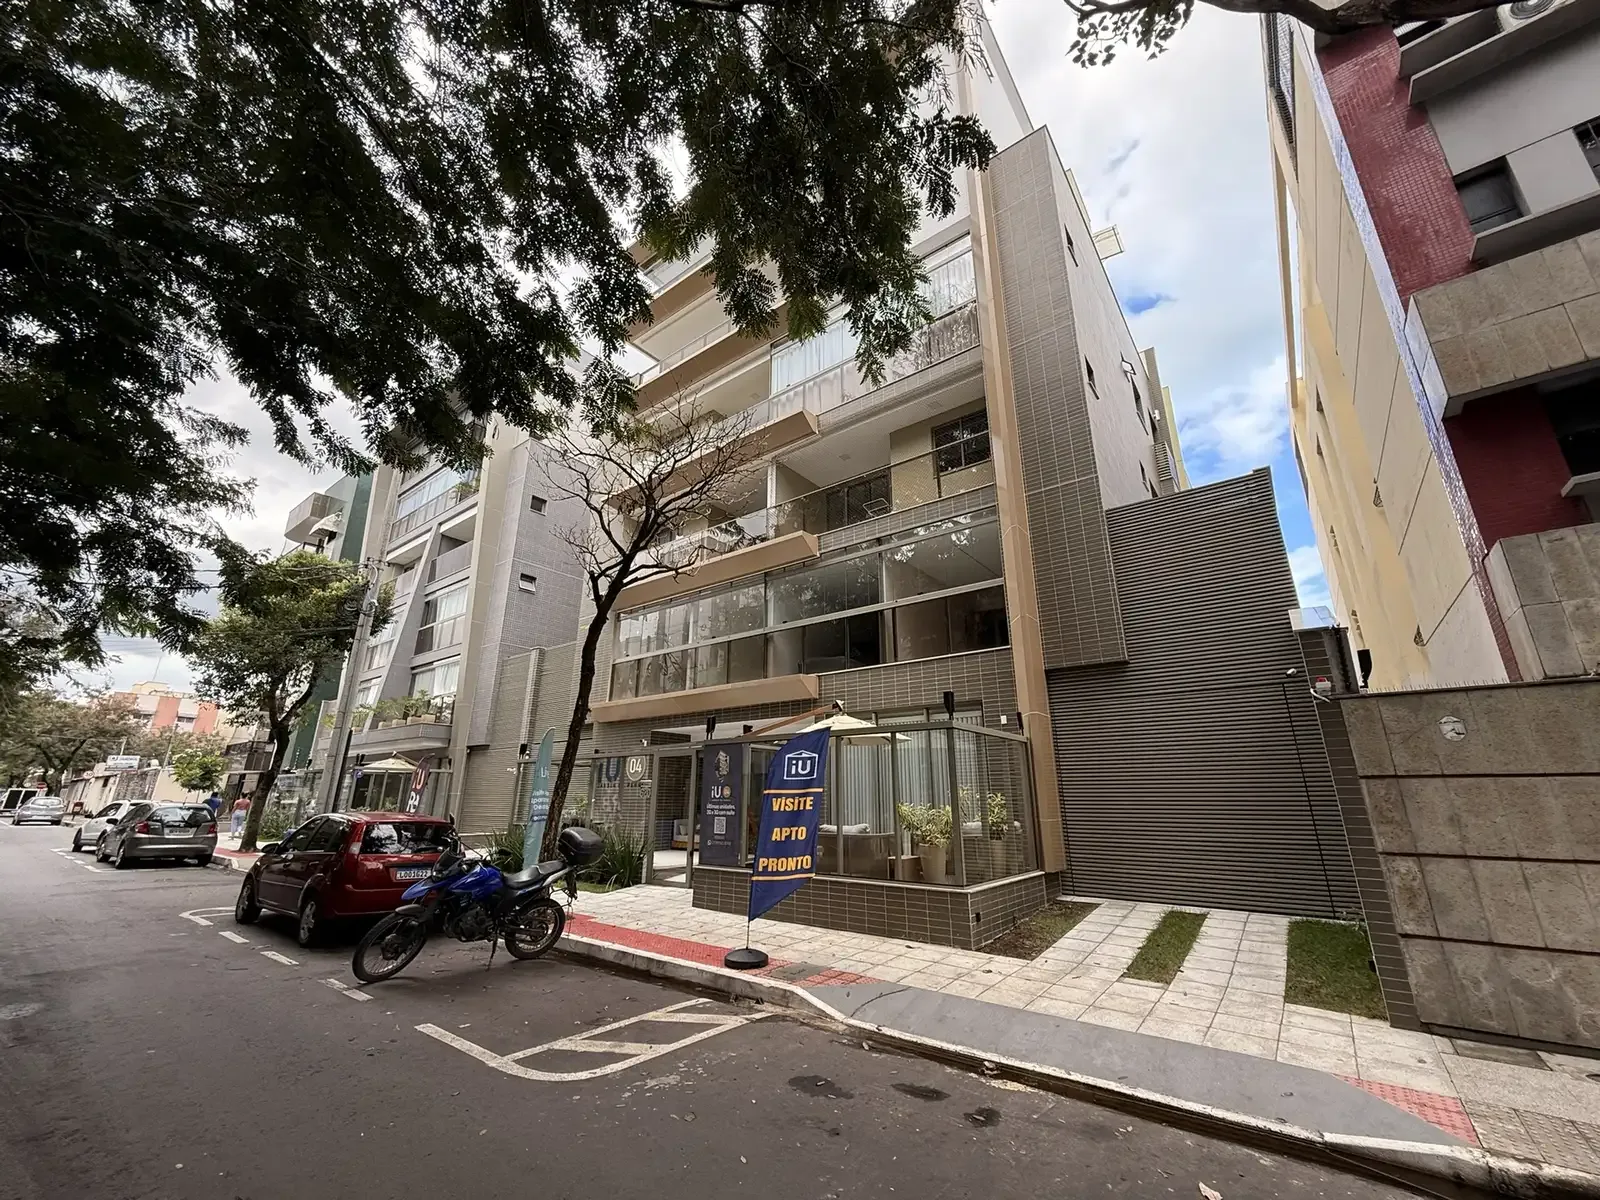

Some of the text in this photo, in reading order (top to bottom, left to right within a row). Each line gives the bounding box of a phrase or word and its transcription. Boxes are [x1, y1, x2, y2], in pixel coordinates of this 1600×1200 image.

[630, 758, 642, 773] 04
[771, 826, 807, 841] APTO
[758, 855, 812, 872] PRONTO
